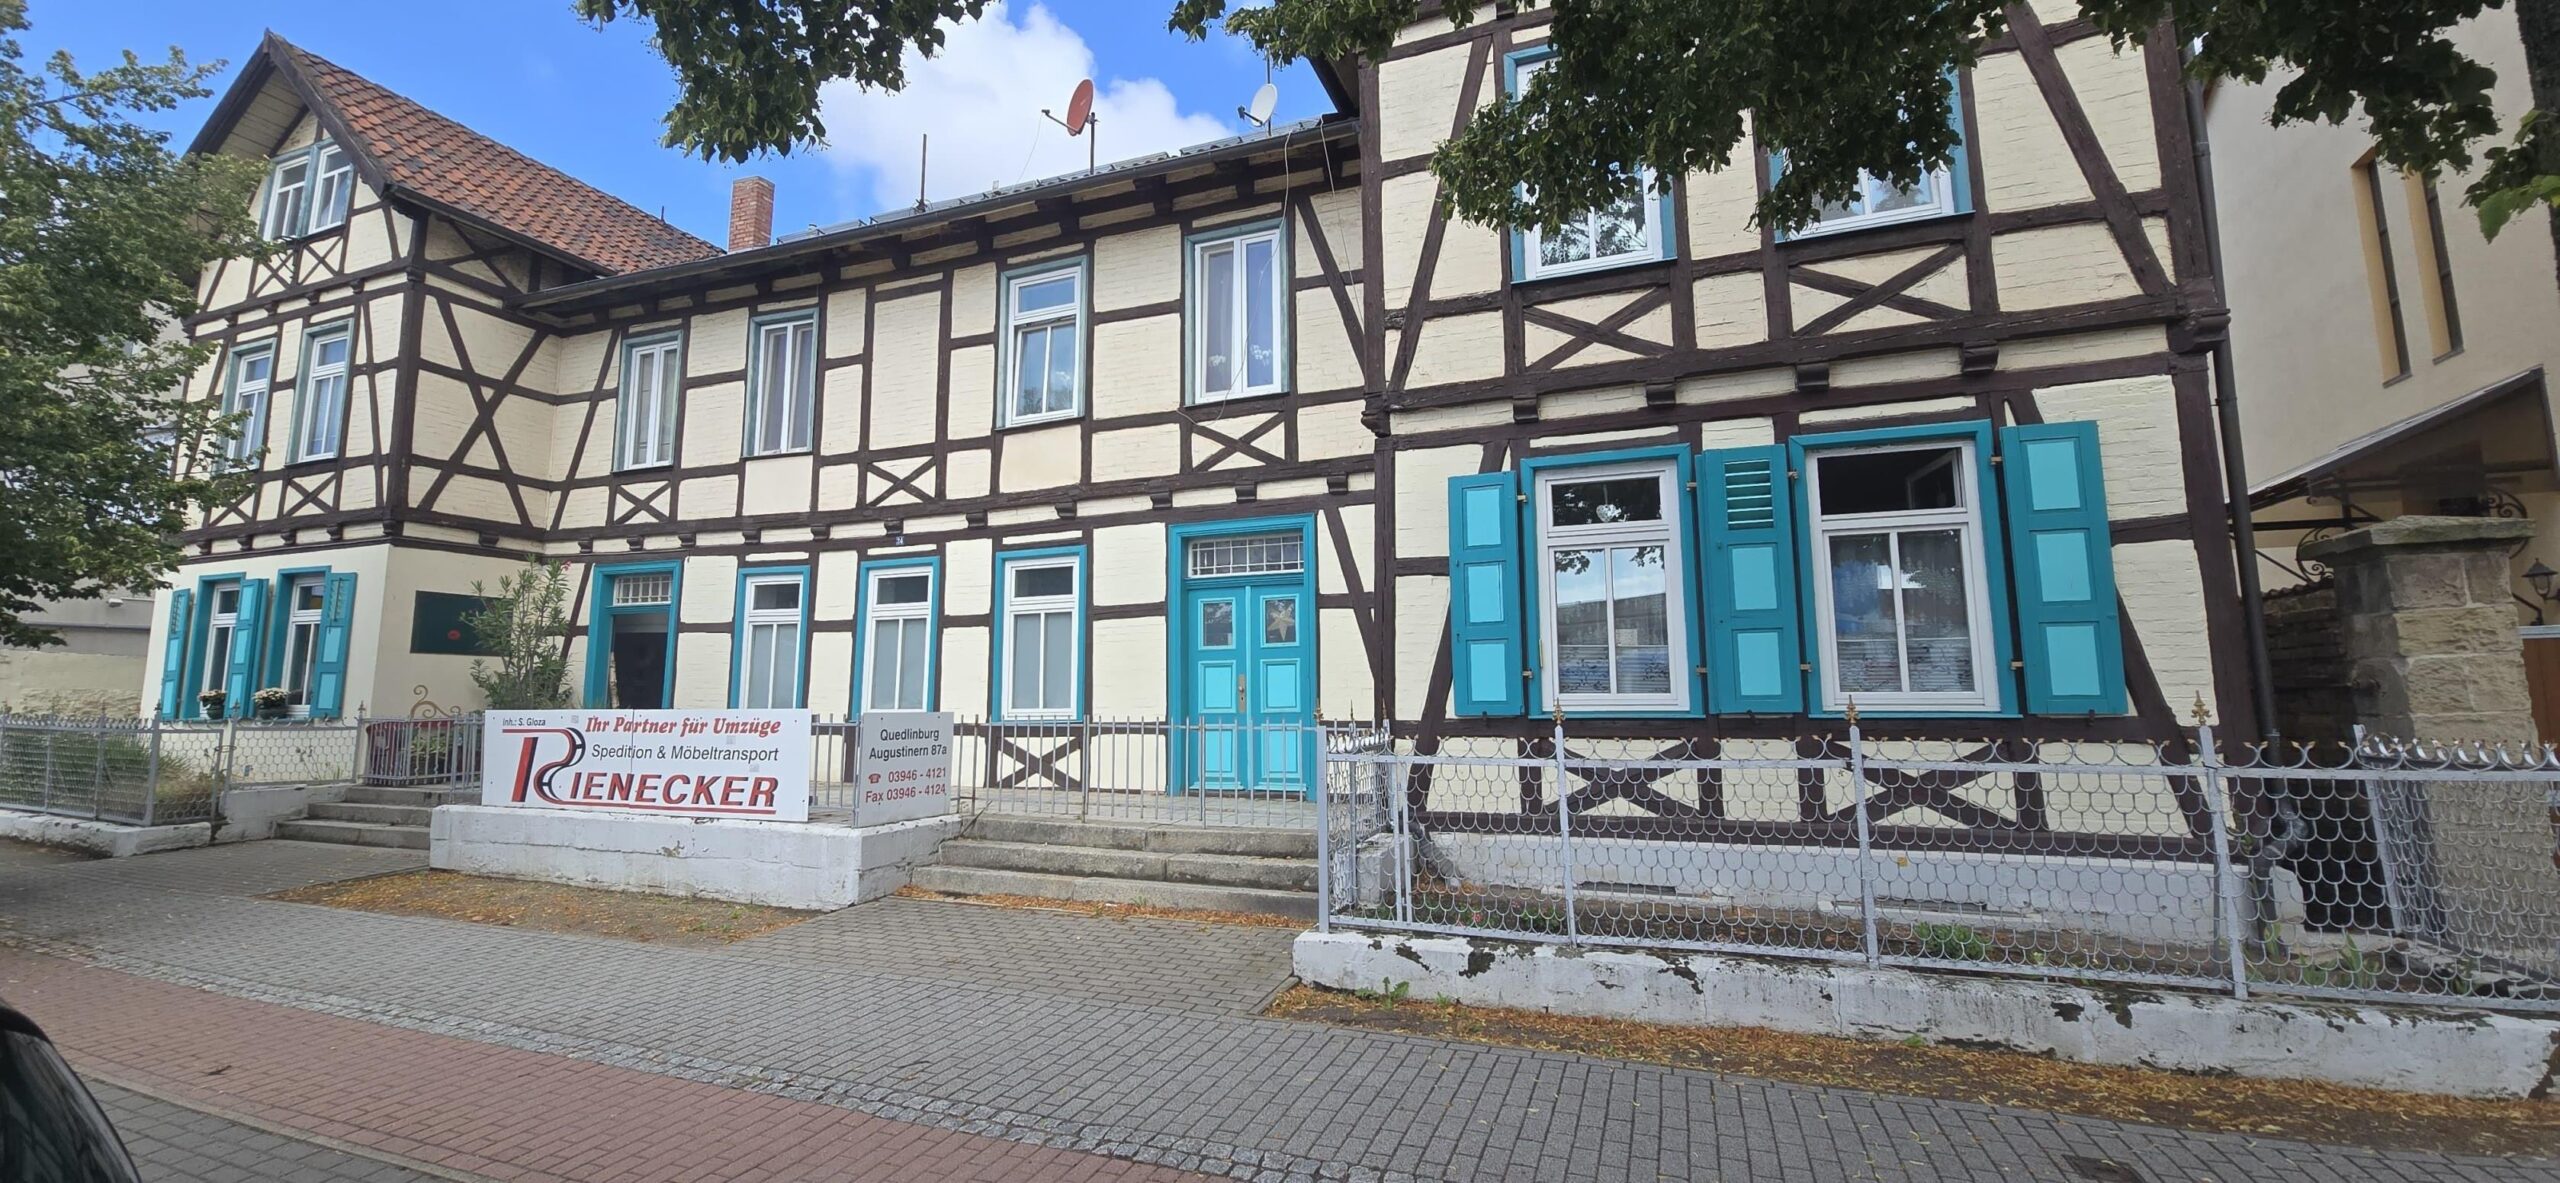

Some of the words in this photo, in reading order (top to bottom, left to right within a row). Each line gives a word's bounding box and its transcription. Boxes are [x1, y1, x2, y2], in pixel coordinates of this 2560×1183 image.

[503, 718, 516, 726] Inh.:
[518, 718, 525, 726] S.
[586, 717, 610, 733] Ihr
[613, 717, 677, 734] Partner
[680, 718, 708, 737] für
[713, 717, 781, 737] Umzüge
[880, 729, 939, 741] Quedlinburg
[591, 744, 652, 760] Spedition
[657, 746, 665, 759] &
[670, 745, 779, 763] Möbeltransport
[869, 746, 928, 761] Augustinern
[931, 745, 947, 755] 87a
[503, 727, 778, 814] RIENECKER
[888, 770, 917, 783] 03946
[926, 767, 946, 778] 4121
[865, 791, 883, 803] Fax
[887, 787, 916, 800] 03946
[925, 784, 945, 795] 4124
